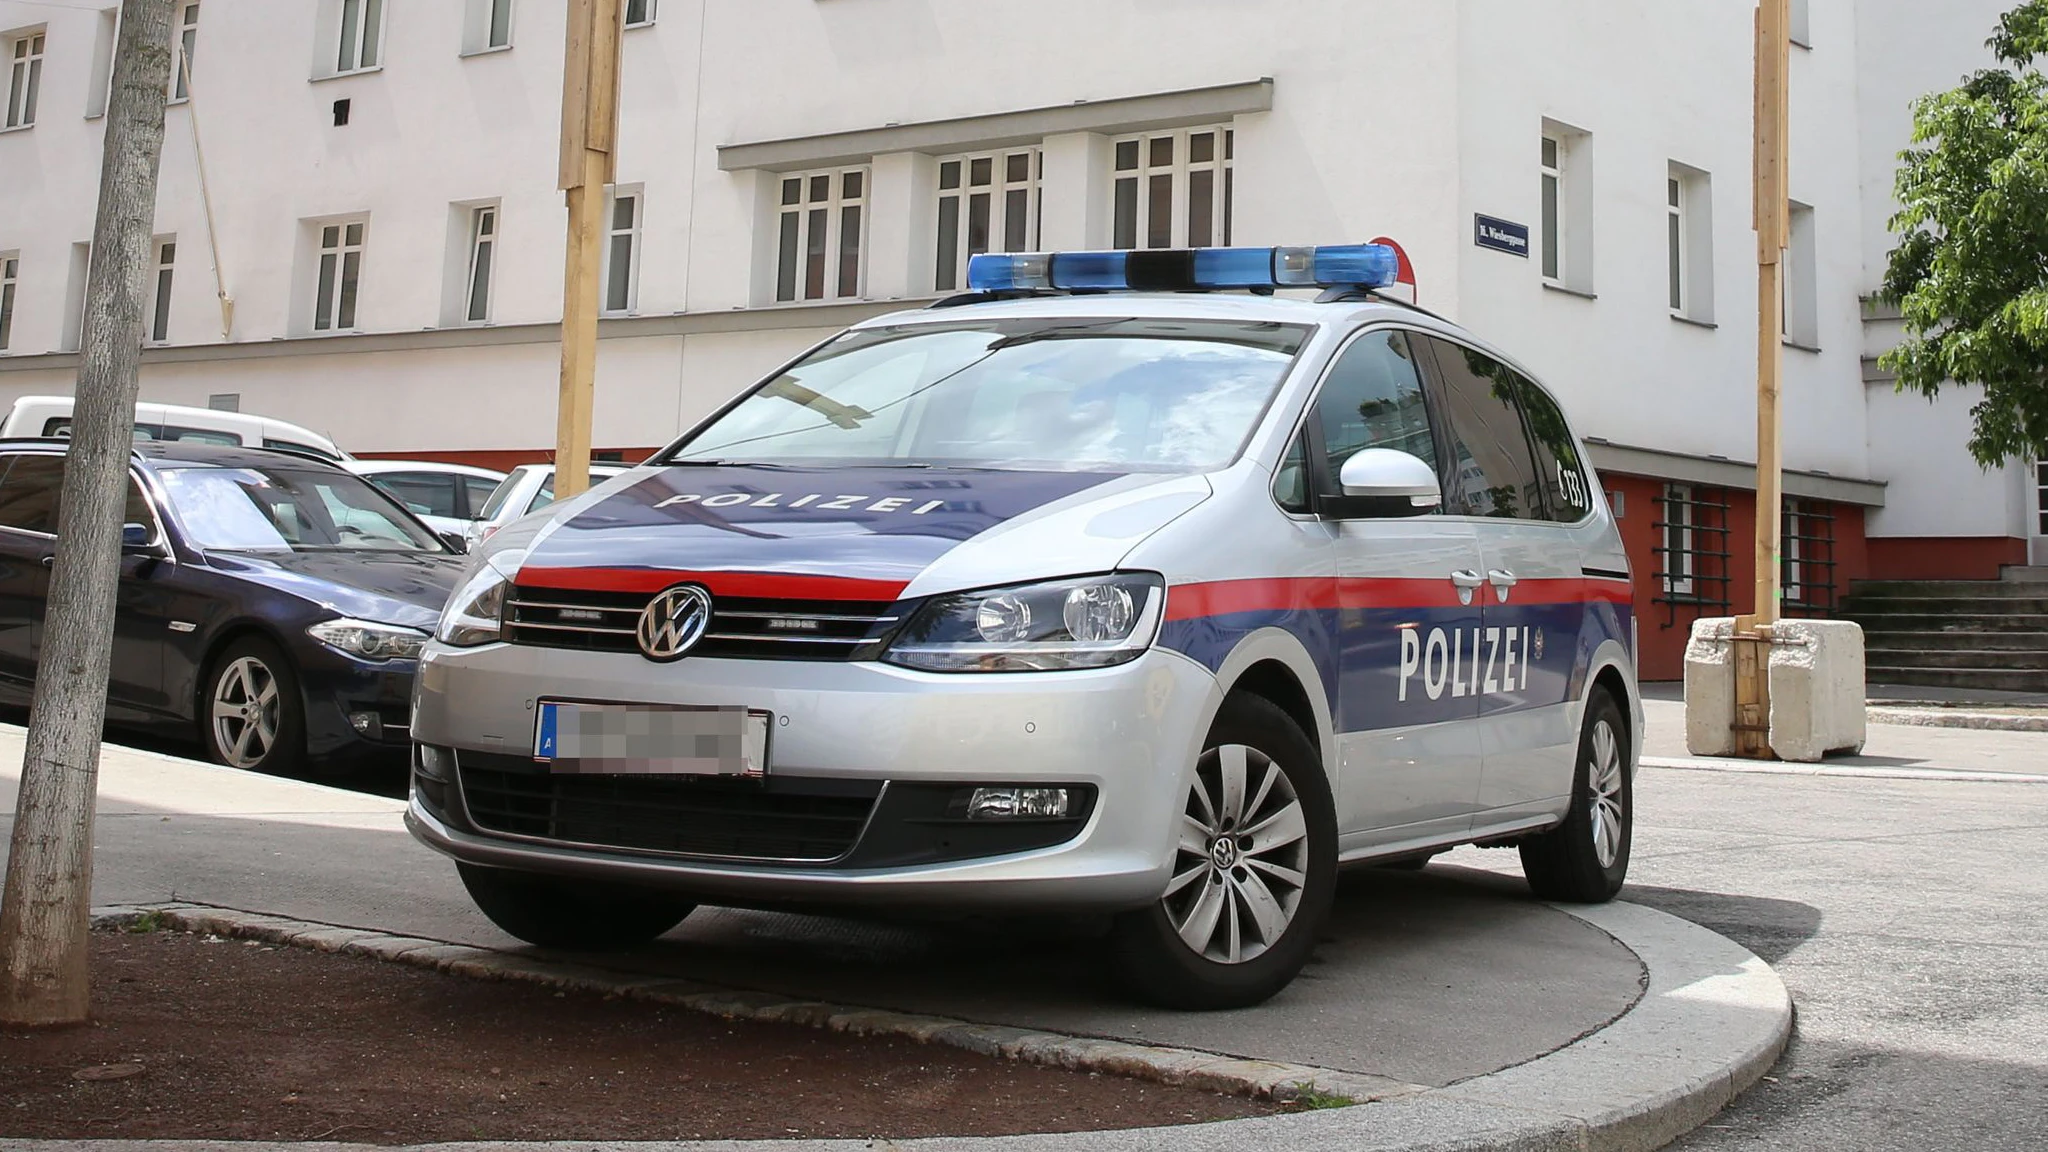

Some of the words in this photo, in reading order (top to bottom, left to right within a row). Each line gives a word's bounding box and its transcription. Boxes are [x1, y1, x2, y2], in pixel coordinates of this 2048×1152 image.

[653, 494, 944, 515] POLIZEI
[1563, 469, 1583, 508] 133
[1398, 626, 1528, 701] POLIZEI
